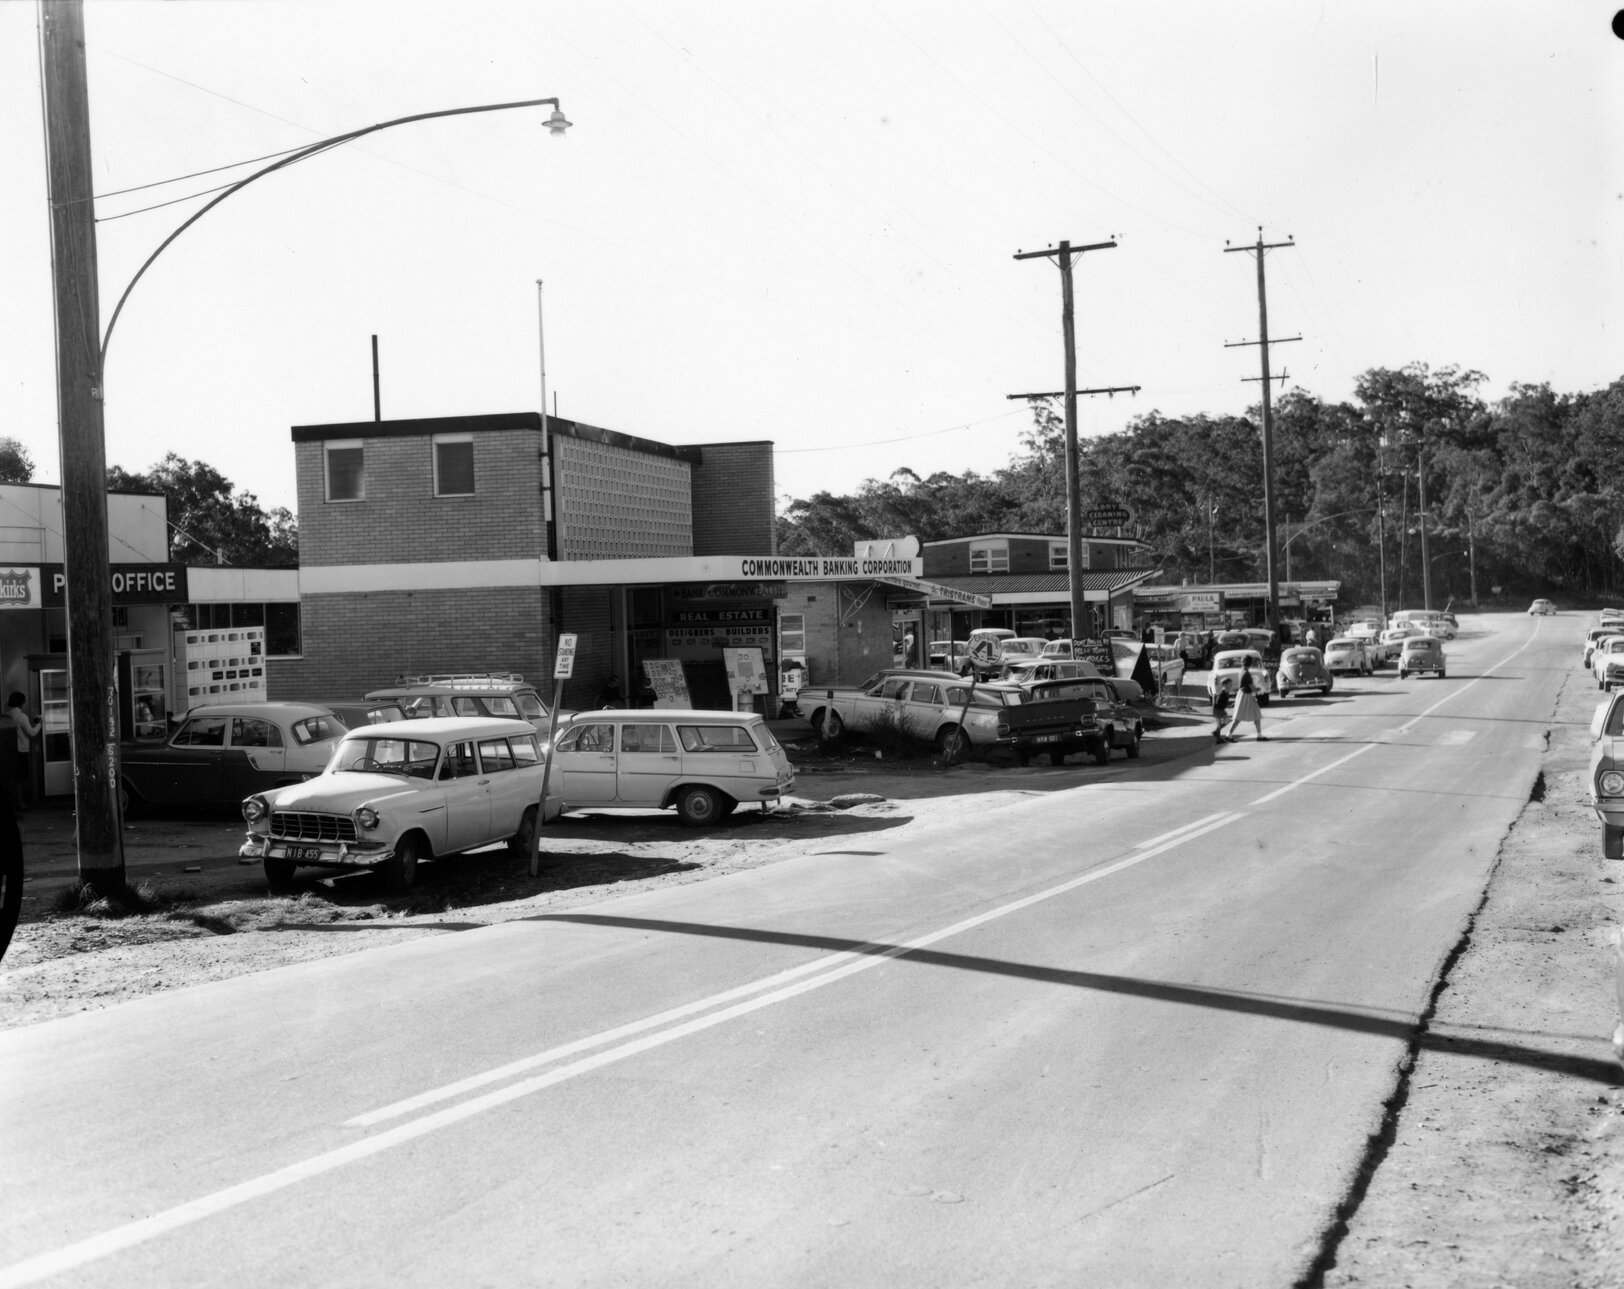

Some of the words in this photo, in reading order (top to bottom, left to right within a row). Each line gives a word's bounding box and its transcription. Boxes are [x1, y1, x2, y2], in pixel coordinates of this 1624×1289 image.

[741, 559, 819, 577] COMMONWEALTH
[823, 560, 859, 576] BANKING
[862, 559, 912, 575] CORPORATION
[112, 572, 176, 593] OFFICE
[679, 612, 710, 622] REAL
[719, 610, 764, 621] ESTATE
[668, 629, 715, 637] DESIGNERS
[725, 627, 770, 636] BUILDERS
[564, 638, 572, 646] NO
[558, 648, 574, 656] STANDING
